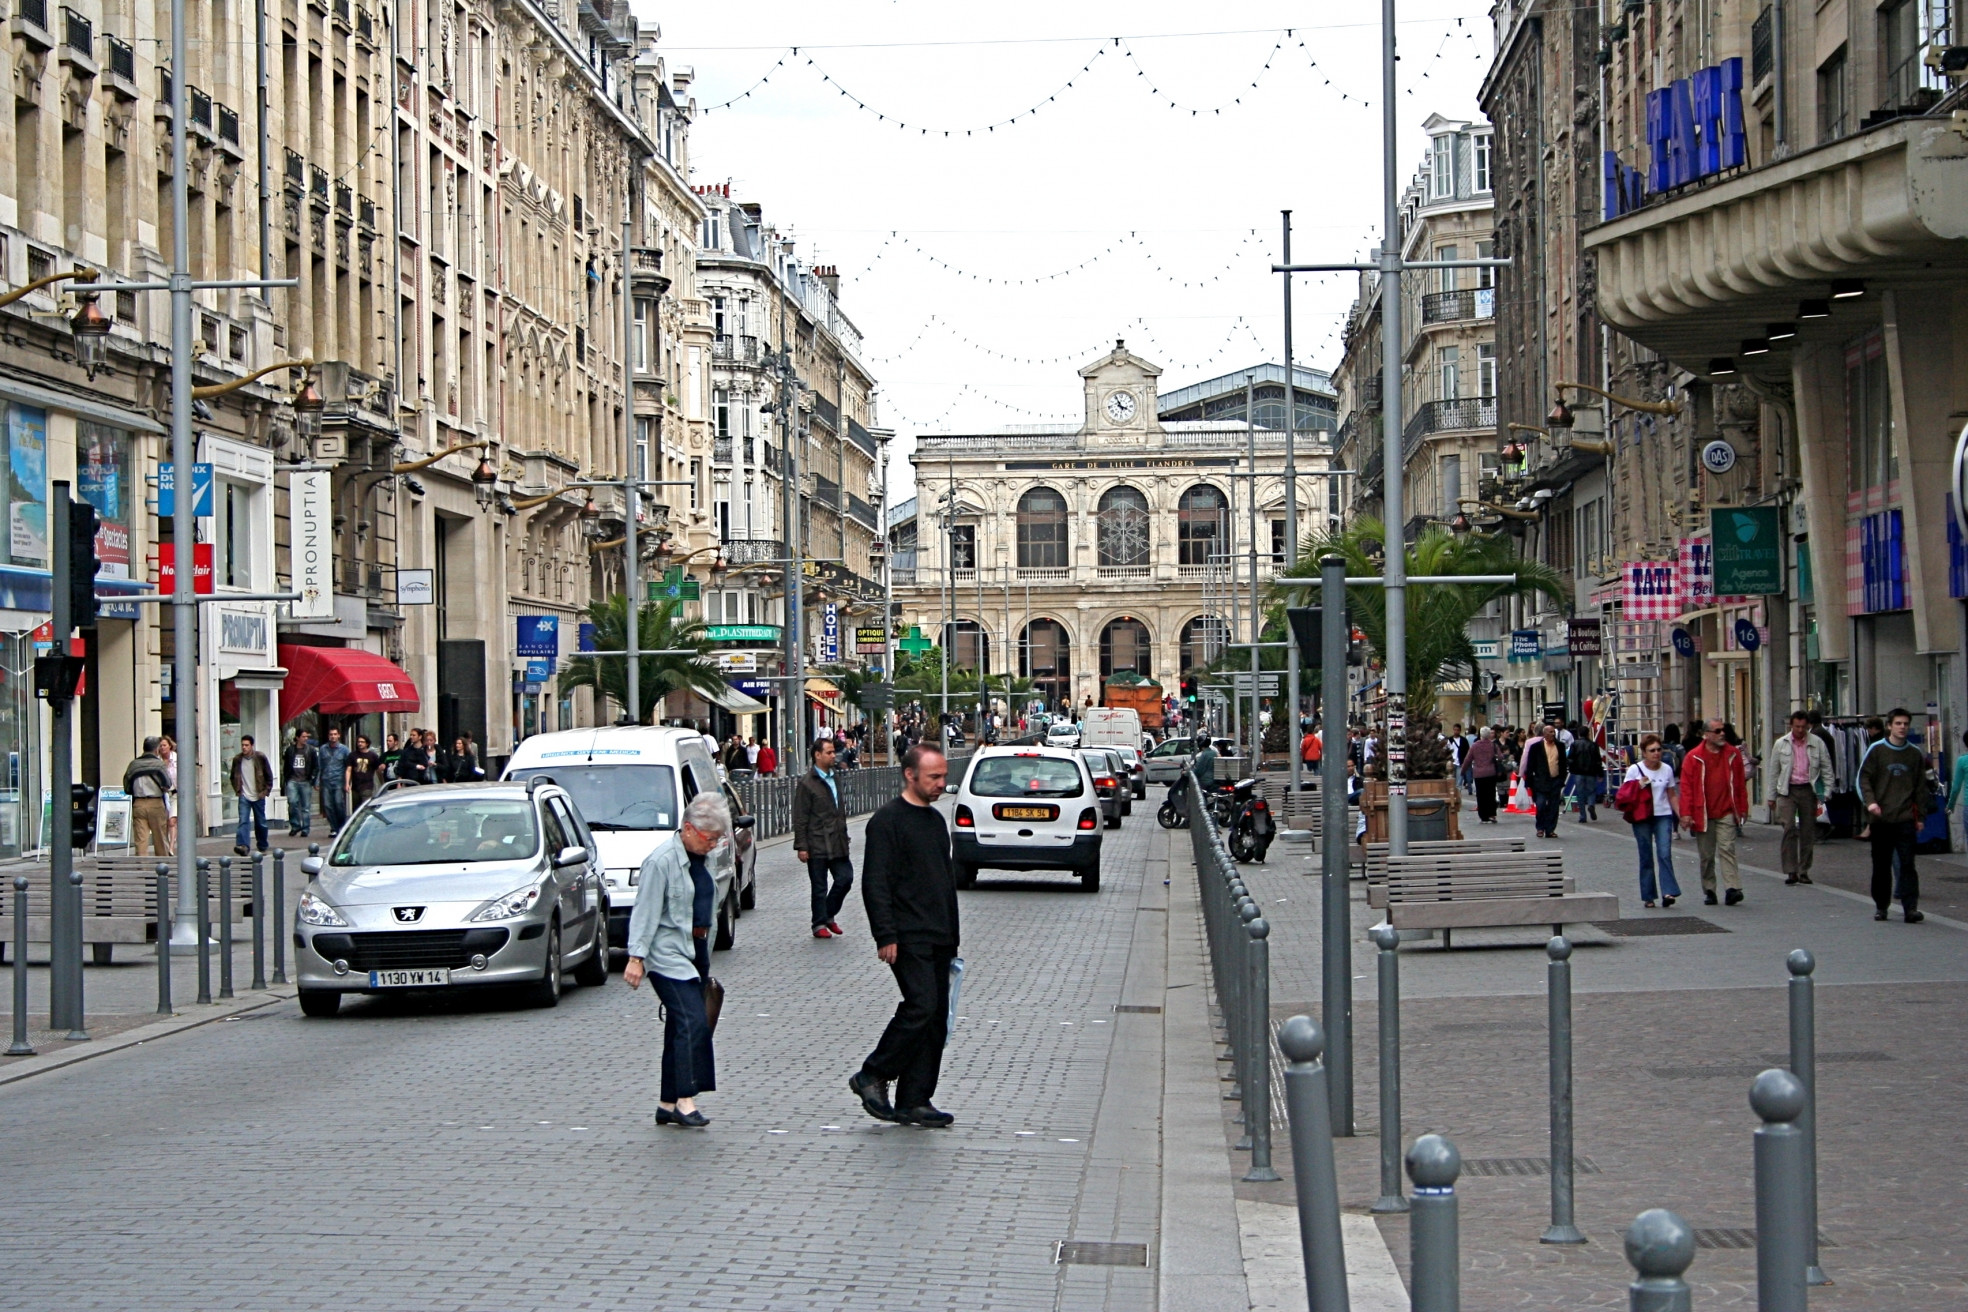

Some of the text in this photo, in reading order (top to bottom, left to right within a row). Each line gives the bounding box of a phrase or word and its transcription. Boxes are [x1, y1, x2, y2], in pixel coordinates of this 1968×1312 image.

[1646, 57, 1744, 195] TATI
[1711, 449, 1728, 464] DAS
[1146, 460, 1195, 468] FLANDRES
[160, 482, 197, 490] NOD
[304, 476, 317, 586] PRONUPTIA
[1691, 544, 1712, 576] TA
[1731, 567, 1769, 581] Agence
[1632, 567, 1672, 596] TATI
[1720, 579, 1776, 593] de Voyages
[221, 613, 267, 650] PRONUPTIA
[825, 604, 836, 656] HOTEL
[1570, 627, 1600, 639] La Boutique
[1739, 628, 1755, 642] 16
[1570, 641, 1577, 651] du
[1579, 640, 1600, 651] Coiffeur
[1676, 637, 1691, 649] 18
[380, 970, 441, 985] 1130 YW 14
